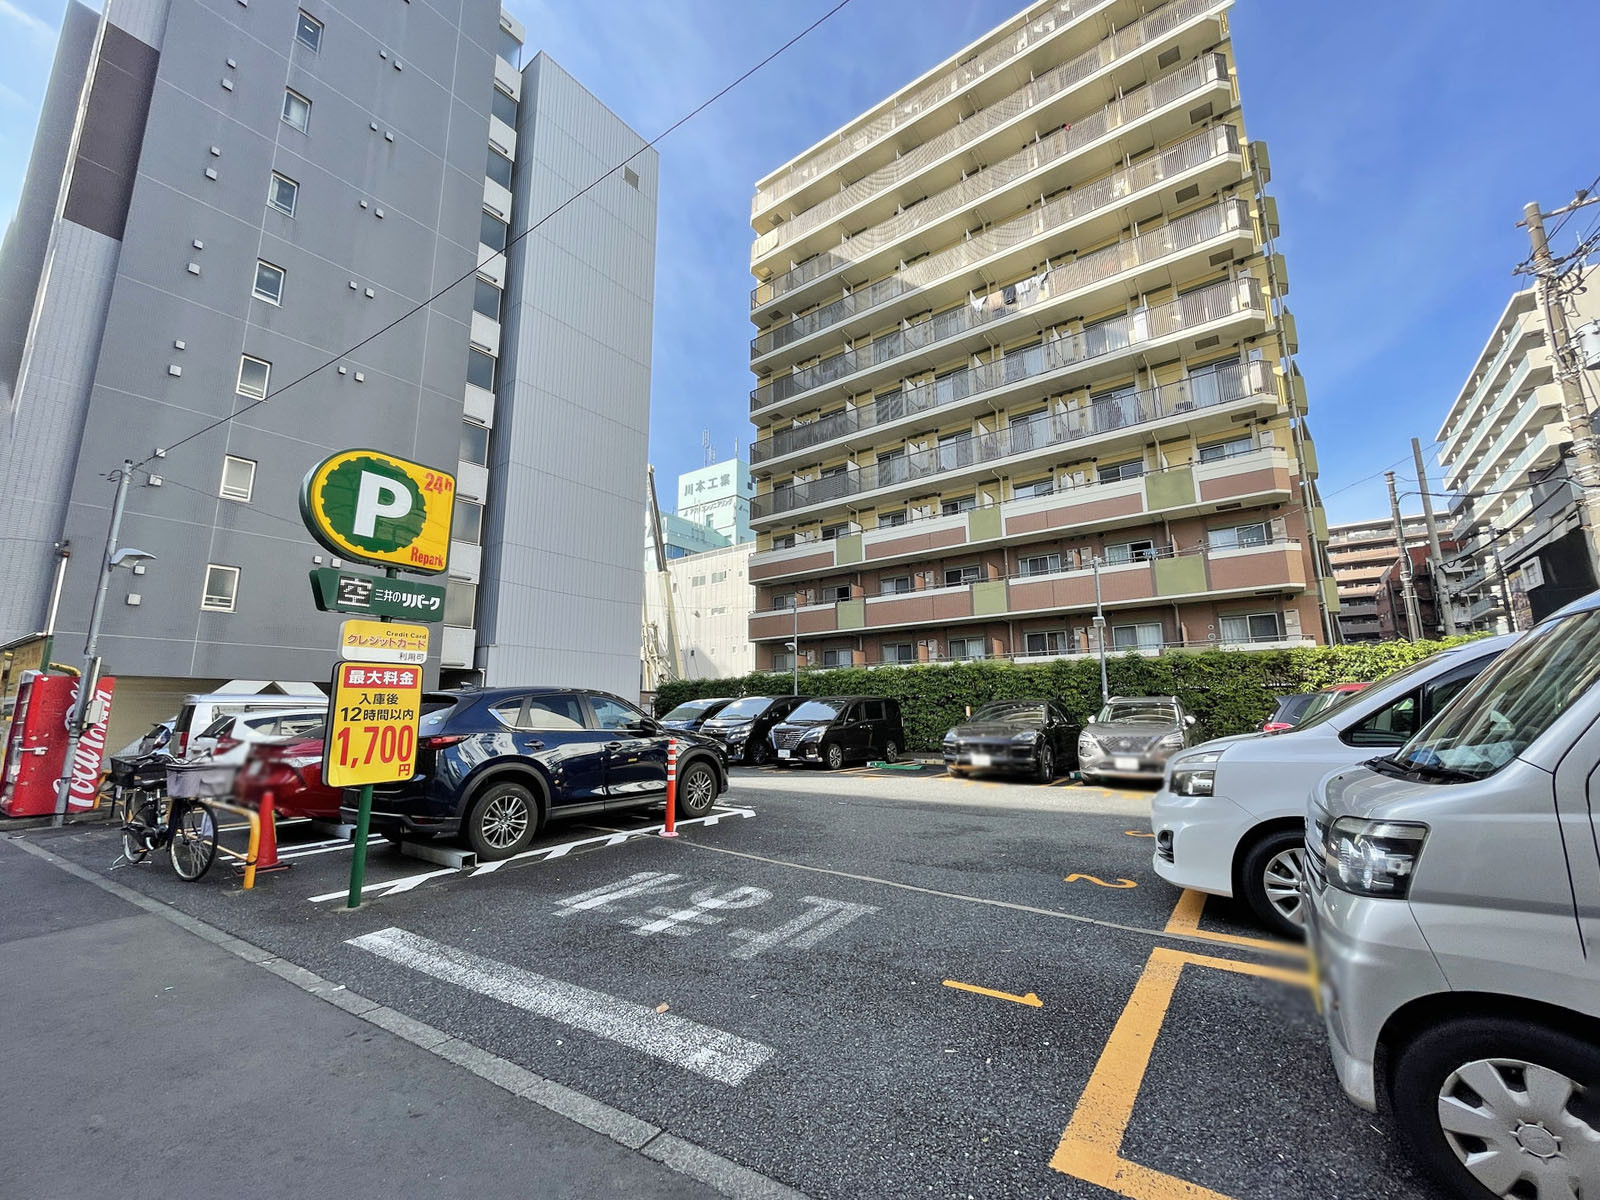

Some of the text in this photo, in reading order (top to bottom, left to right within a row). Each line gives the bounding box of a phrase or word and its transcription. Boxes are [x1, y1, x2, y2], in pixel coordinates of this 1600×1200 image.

[424, 472, 452, 495] 24h
[684, 473, 730, 497] 川本工業
[353, 470, 412, 538] P
[410, 546, 443, 567] Repark
[337, 576, 372, 607] 空
[375, 588, 440, 611] 三井のリパーク
[347, 633, 426, 649] クレジットカード
[386, 630, 427, 640] Credit Card
[399, 651, 425, 662] 利用可
[348, 669, 414, 685] 最大料金
[359, 693, 398, 705] 入庫後
[340, 706, 414, 722] 12時間以内
[337, 725, 414, 769] 1,700
[398, 763, 411, 777] 円
